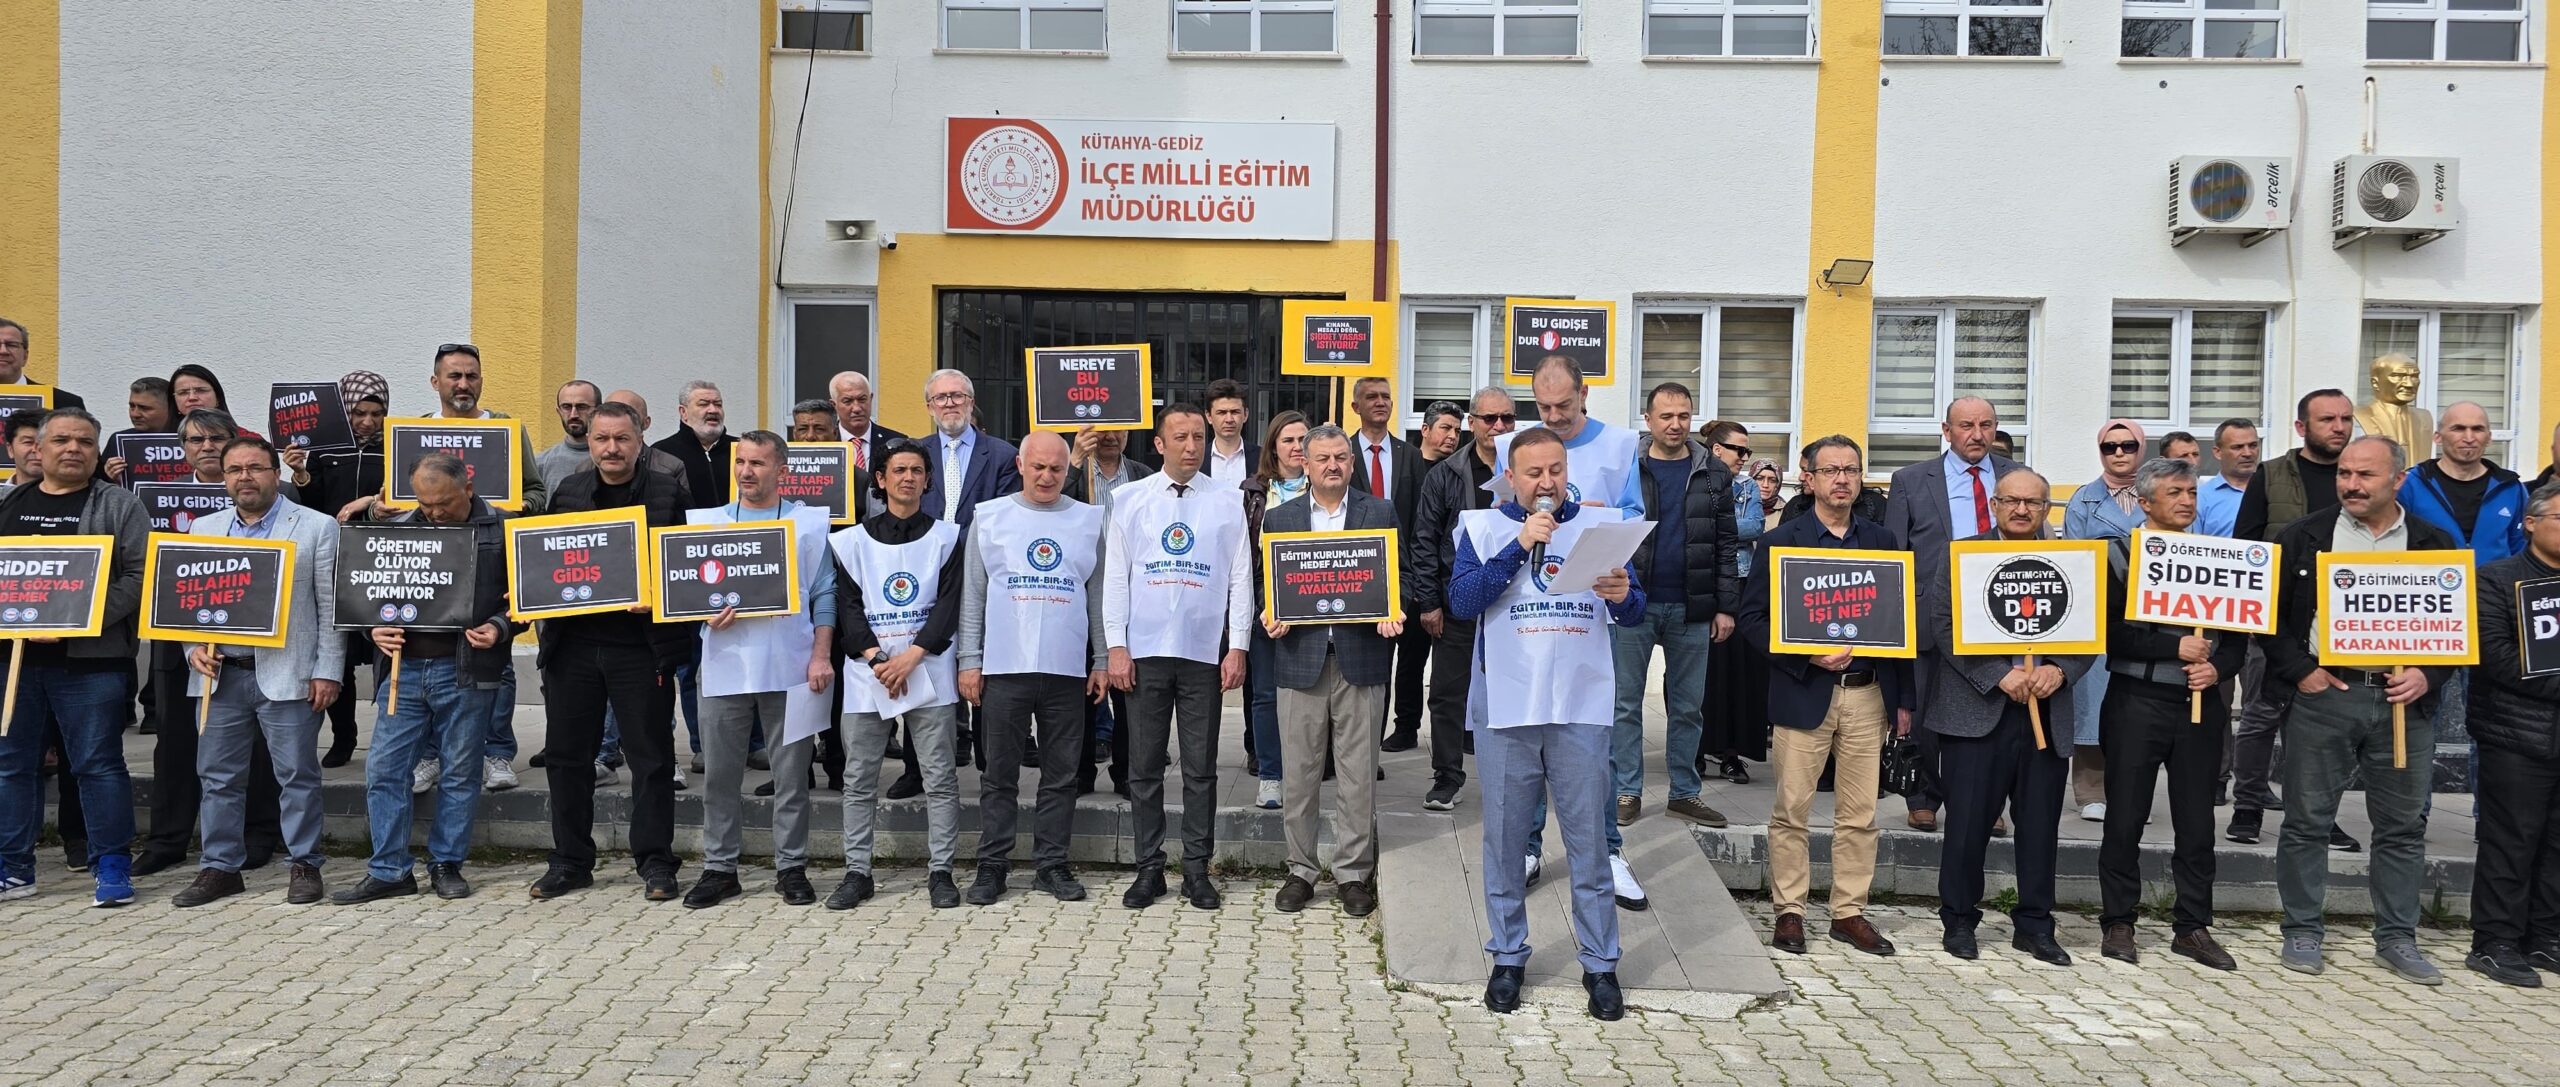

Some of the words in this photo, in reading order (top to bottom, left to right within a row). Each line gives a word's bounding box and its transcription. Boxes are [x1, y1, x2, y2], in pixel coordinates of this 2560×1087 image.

[1082, 133, 1204, 150] KÜTAHYA-GEDİZ
[1081, 157, 1134, 190] İLÇE
[1142, 158, 1211, 186] MİLLİ
[1218, 160, 1310, 187] EĞİTİM
[2266, 162, 2281, 208] arçelik
[1082, 194, 1255, 222] MÜDÜRLÜĞÜ
[1532, 318, 1548, 328] BU
[1550, 318, 1588, 331] GİDİŞE
[1518, 336, 1539, 345] DUR
[1561, 337, 1600, 346] DİYELİM
[1060, 358, 1116, 370] NEREYE
[1077, 372, 1099, 385] BU
[274, 390, 317, 409] OKULDA
[1068, 387, 1109, 402] GİDİŞ
[276, 404, 320, 423] SİLAHIN
[294, 418, 318, 431] NE?
[420, 435, 482, 448] NEREYE
[145, 446, 185, 462] ŞİDD
[134, 464, 152, 473] ACI
[156, 464, 171, 473] VE
[800, 475, 834, 486] KARŞI
[776, 486, 823, 495] AKTAYIZ
[158, 496, 180, 508] BU
[151, 518, 169, 528] UR
[366, 537, 442, 553] ÖĞRETMEN
[544, 533, 608, 551] NEREYE
[564, 549, 589, 565] BU
[686, 544, 708, 558] BU
[711, 542, 762, 557] GİDİŞE
[1280, 551, 1311, 561] EĞİTİM
[1314, 549, 1377, 559] KURUMLARINI
[2171, 543, 2243, 560] ÖĞRETMENE
[176, 557, 251, 578] OKULDA
[374, 553, 431, 569] ÖLÜYOR
[1300, 560, 1330, 569] HEDEF
[1332, 559, 1358, 568] ALAN
[350, 570, 400, 585] ŞİDDET
[403, 572, 453, 585] YASASI
[553, 565, 602, 583] GİDİŞ
[670, 569, 698, 581] DUR
[727, 563, 779, 577] DİYELİM
[1286, 571, 1335, 585] ŞİDDETE
[1338, 570, 1373, 582] KARŞI
[2148, 559, 2263, 590] ŞİDDETE
[2359, 573, 2437, 586] EĞİTİMCİLER
[0, 580, 18, 590] VE
[22, 578, 84, 591] GÖZYAŞI
[175, 572, 251, 593] SİLAHIN
[1803, 570, 1876, 590] OKULDA
[366, 586, 434, 600] ÇIKMIYOR
[1298, 582, 1362, 595] AYAKTAYIZ
[1993, 582, 2063, 597] ŞİDDETE
[0, 592, 48, 602] DEMEK
[180, 594, 203, 610] İŞİ
[210, 589, 245, 606] NE?
[1803, 586, 1876, 608] SİLAHIN
[2344, 594, 2452, 613] HEDEFSE
[2532, 598, 2560, 610] EĞİT
[1809, 606, 1832, 624] İŞİ
[1838, 603, 1872, 619] NE?
[2143, 590, 2263, 625] HAYIR
[2014, 618, 2040, 633] DE
[2334, 617, 2463, 632] GELECEĞİMİZ
[2334, 639, 2464, 651] KARANLIKTIR
